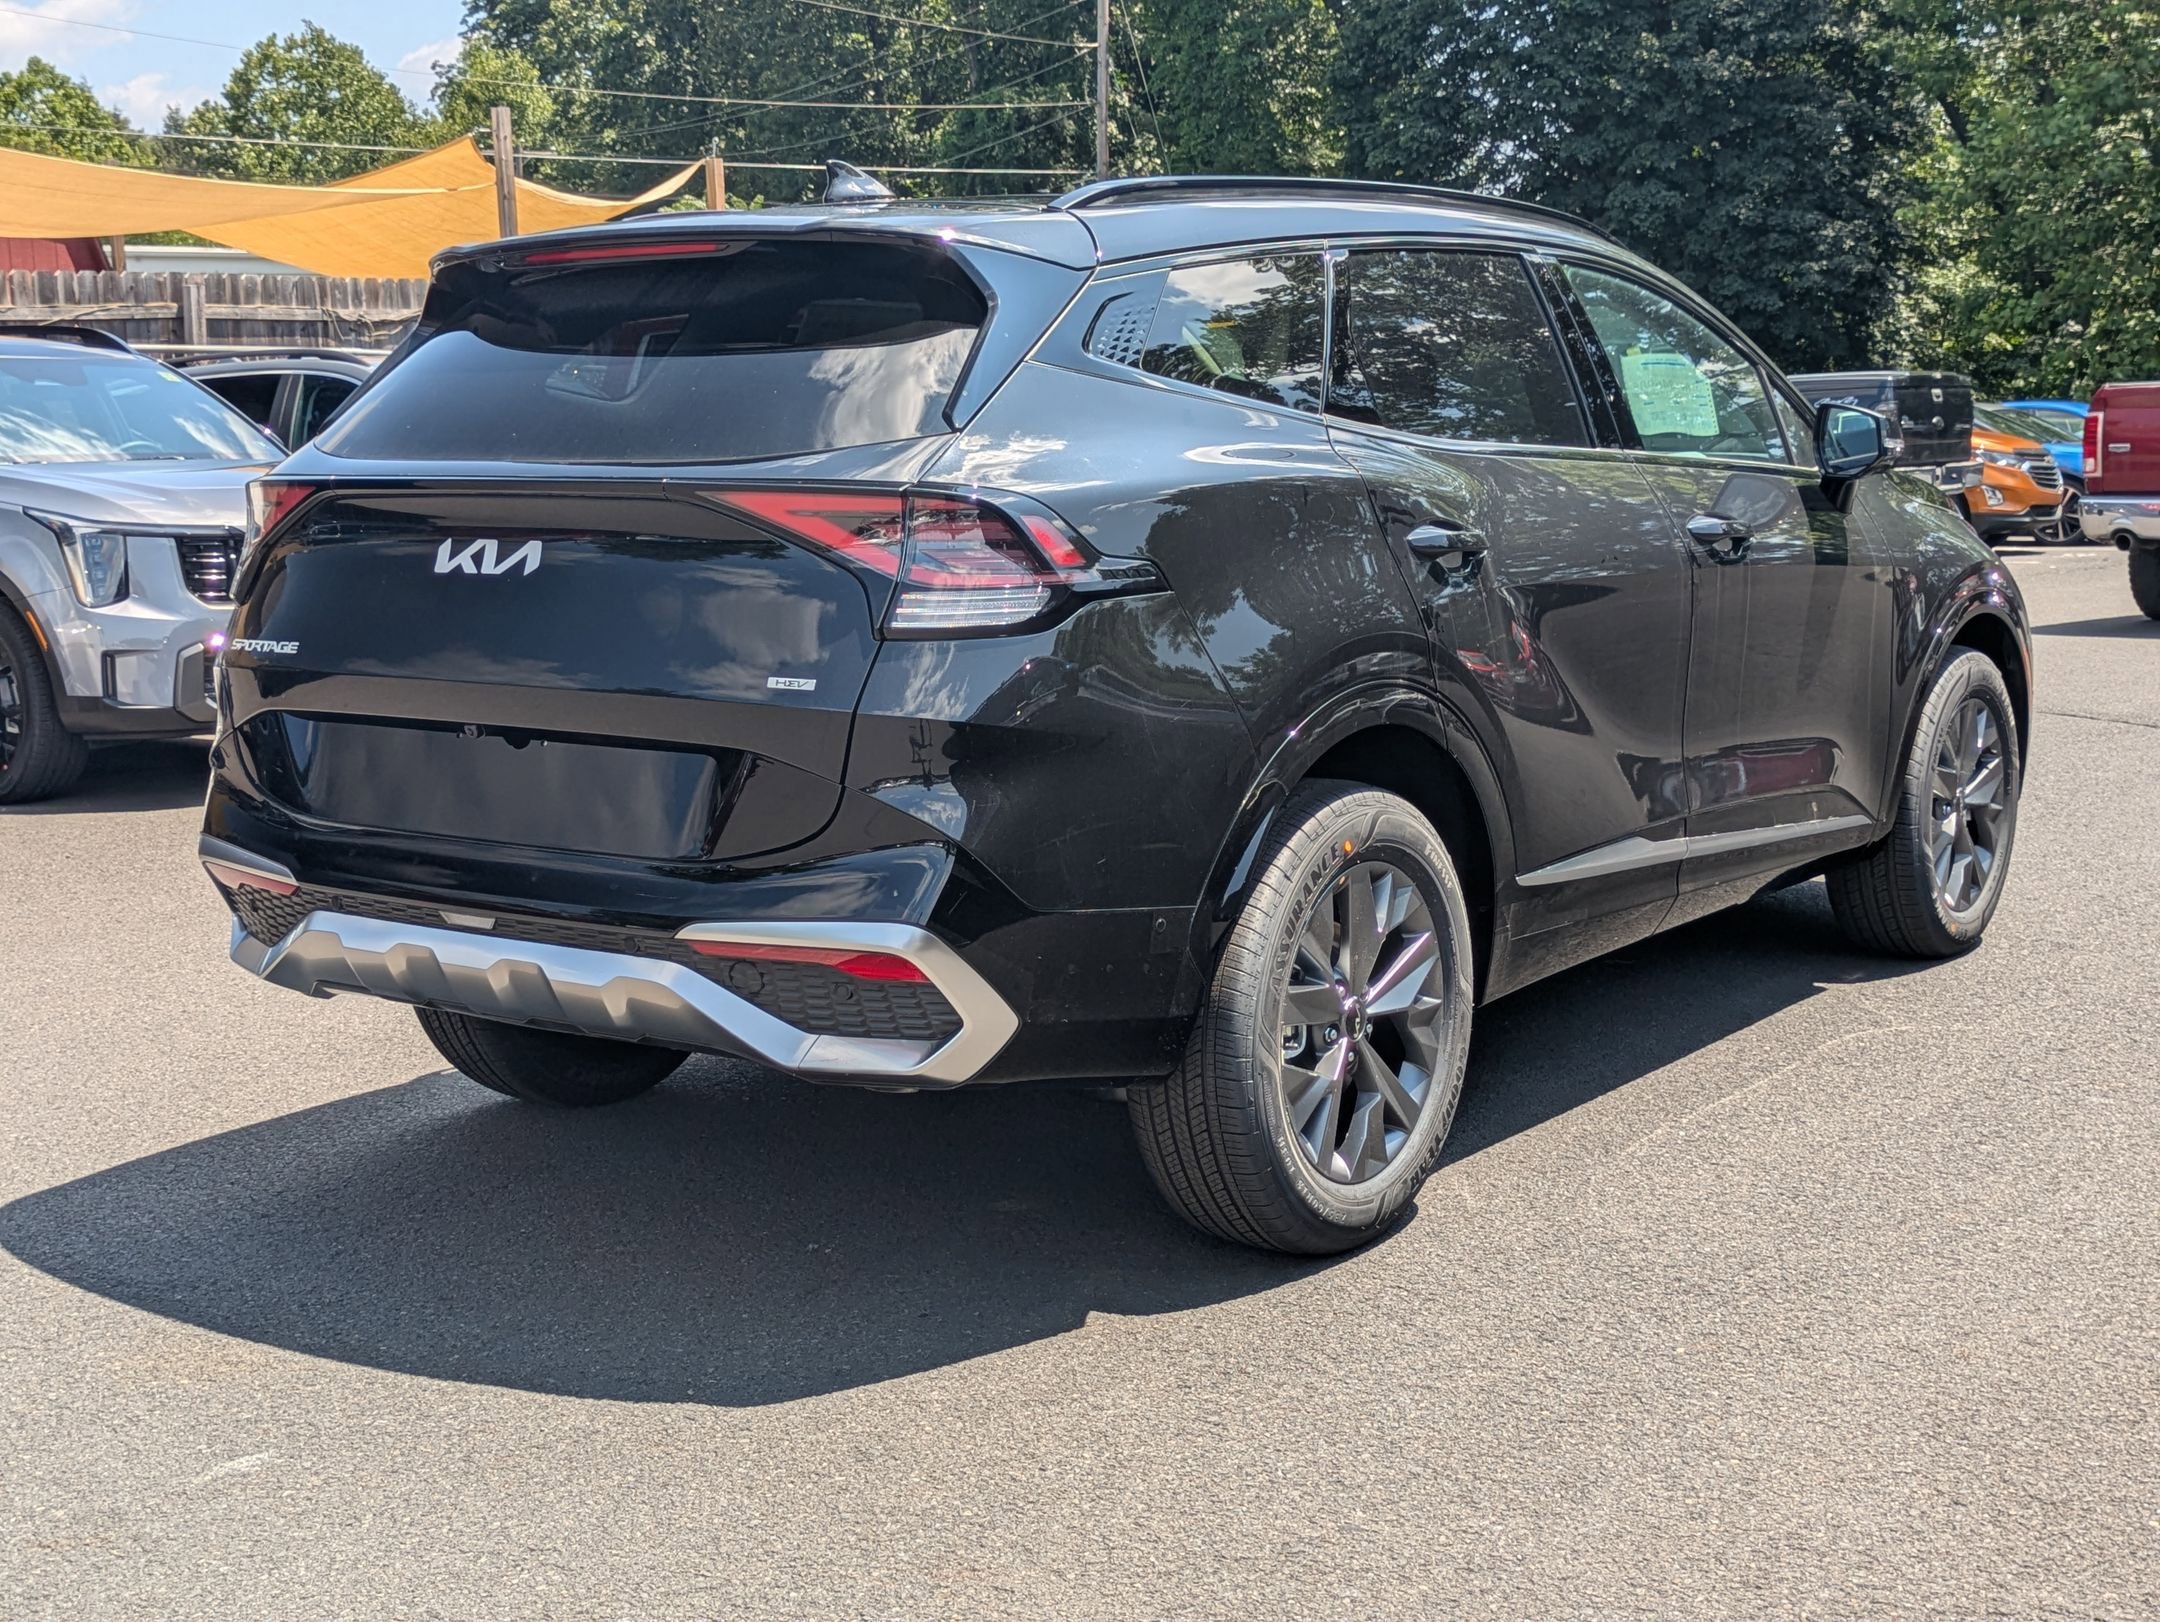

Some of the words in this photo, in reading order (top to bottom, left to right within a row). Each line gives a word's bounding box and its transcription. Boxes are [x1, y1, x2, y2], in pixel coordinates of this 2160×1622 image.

[434, 537, 542, 576] KIA
[231, 638, 299, 654] SPORTAGE
[774, 678, 811, 689] HEV
[1271, 841, 1340, 996] ASSURANCE
